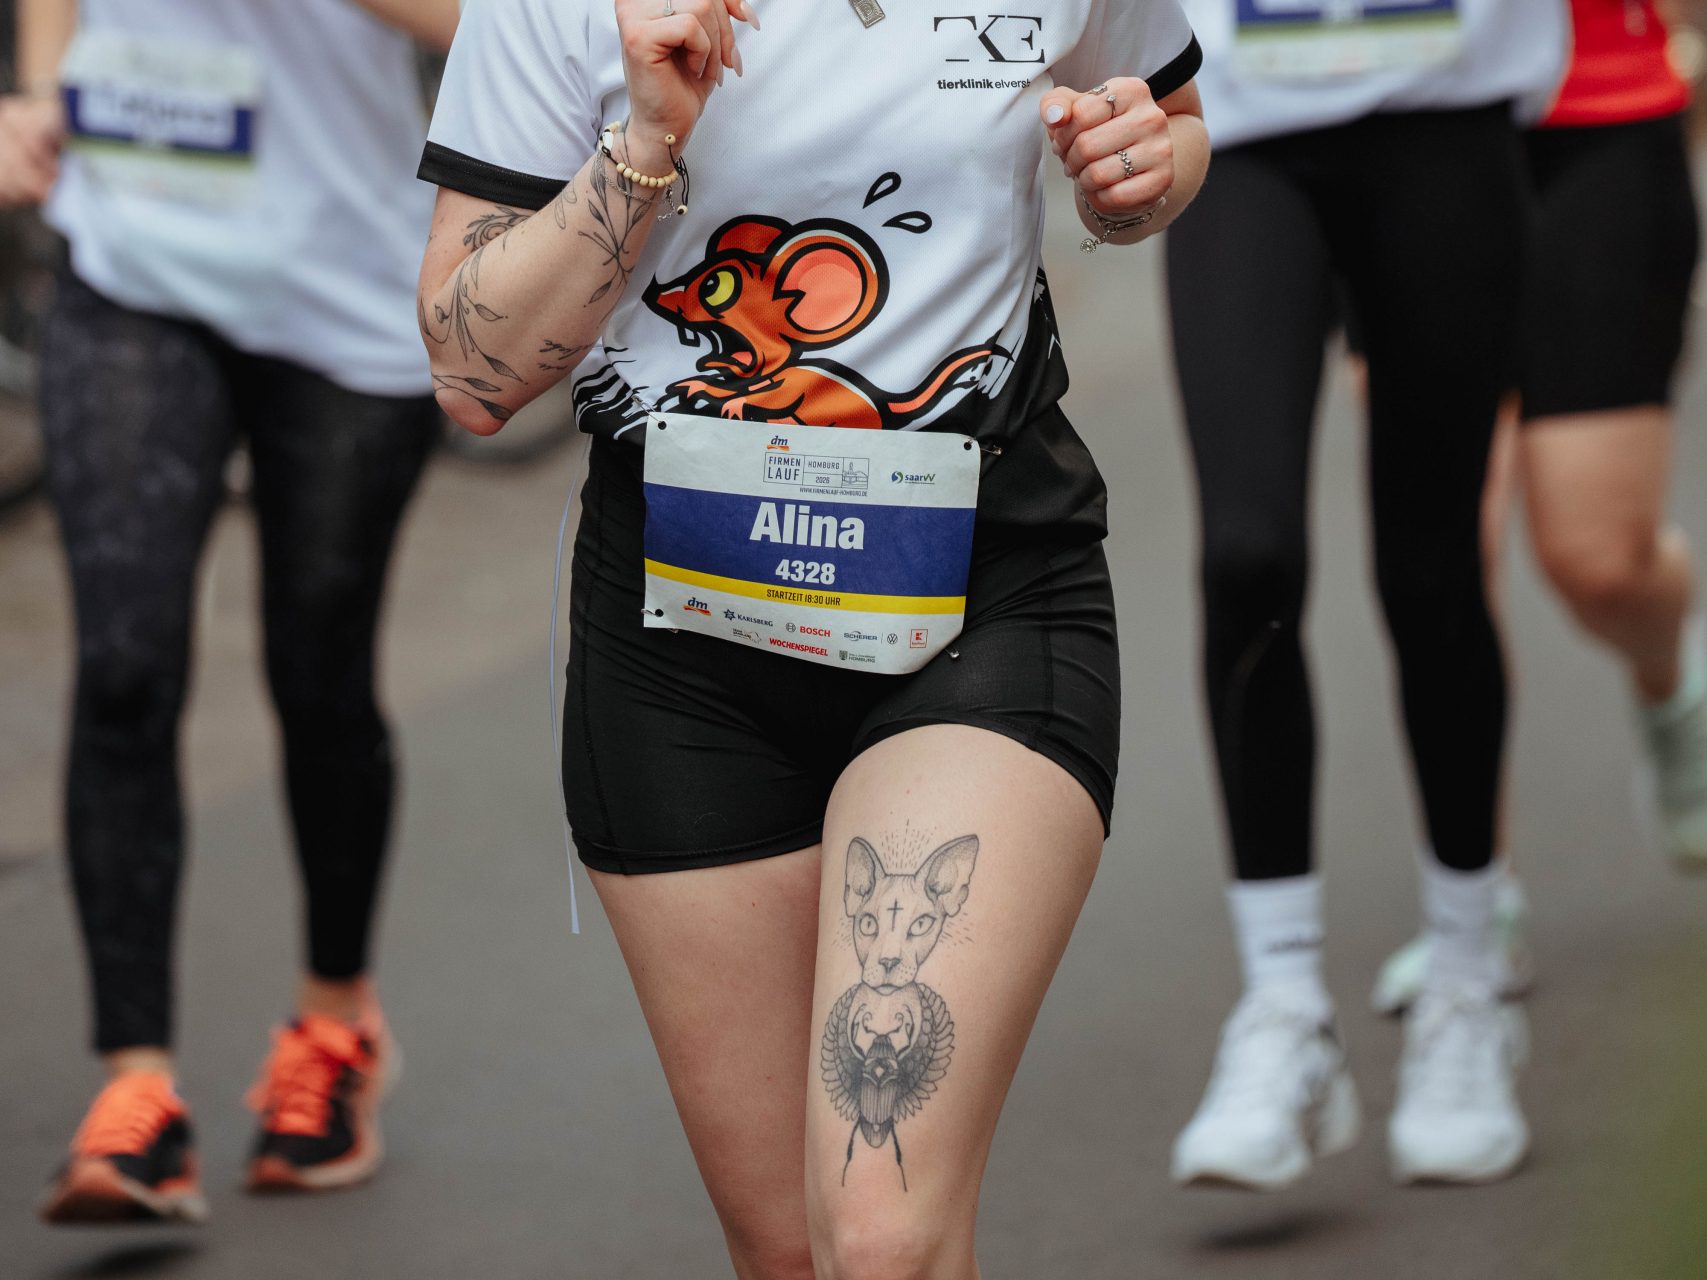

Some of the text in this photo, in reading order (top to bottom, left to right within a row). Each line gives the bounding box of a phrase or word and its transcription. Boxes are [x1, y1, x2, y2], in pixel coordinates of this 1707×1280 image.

[937, 79, 994, 90] tierklinik
[770, 435, 789, 447] dm
[768, 456, 801, 467] FIRMEN
[807, 461, 840, 470] HOMBURG
[767, 467, 801, 481] LAUF
[815, 476, 830, 484] 2026
[749, 501, 865, 550] Alina
[775, 559, 836, 585] 4328
[766, 588, 841, 606] STARTZEIT 18:30 UHR
[687, 597, 708, 610] dm
[738, 614, 773, 627] KARLSBERG
[800, 626, 831, 638] BOSCH
[843, 631, 878, 641] SCHERER
[769, 637, 829, 657] WOCHENSPIEGEL
